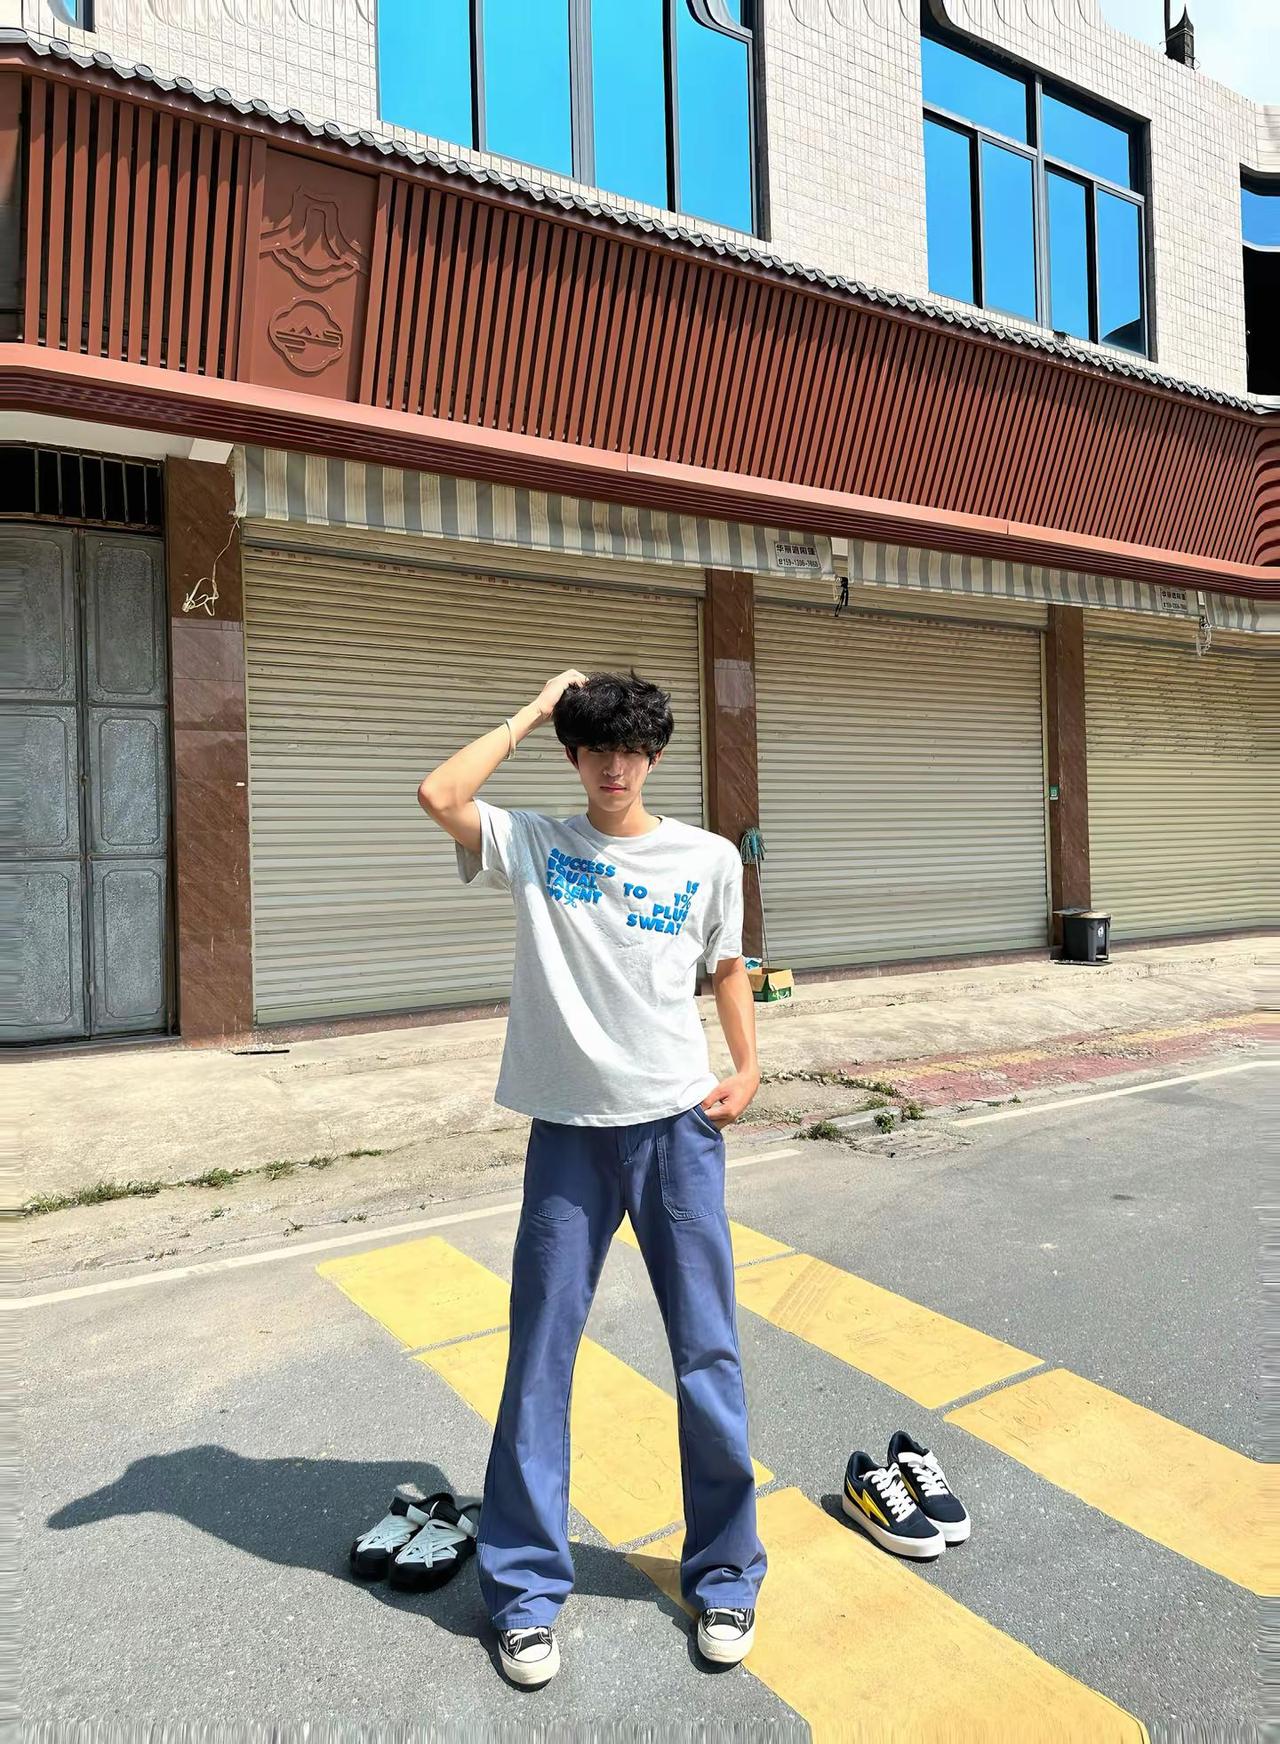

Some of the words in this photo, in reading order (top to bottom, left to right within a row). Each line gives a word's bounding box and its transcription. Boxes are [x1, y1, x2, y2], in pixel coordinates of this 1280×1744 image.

[547, 857, 598, 890] EQUAL
[623, 882, 648, 899] TO
[674, 892, 692, 910] 1%
[549, 847, 616, 878] SUCCESS
[686, 880, 700, 895] IS
